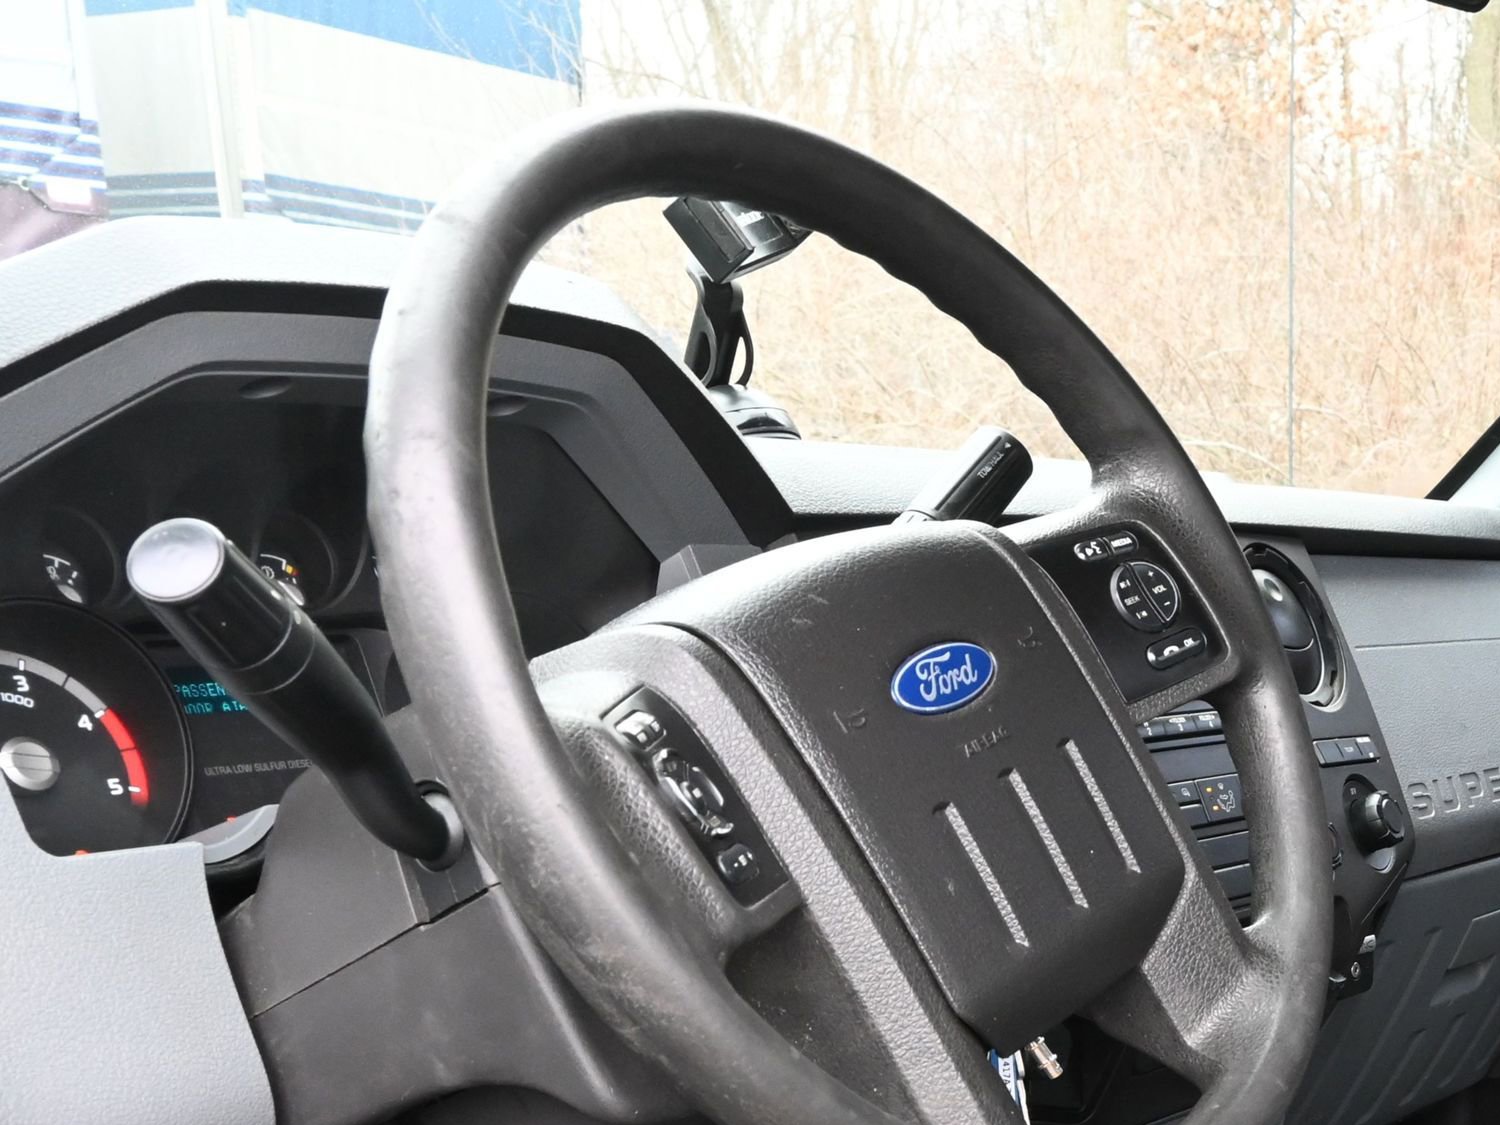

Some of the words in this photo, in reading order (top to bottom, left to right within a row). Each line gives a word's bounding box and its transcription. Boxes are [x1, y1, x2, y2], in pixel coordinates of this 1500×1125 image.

[1152, 584, 1167, 595] VOL
[1124, 595, 1141, 607] SEEK
[1183, 637, 1195, 648] OK
[12, 675, 30, 692] 3
[915, 651, 978, 702] Ford
[173, 682, 227, 698] PASSEN
[77, 714, 94, 731] 4
[203, 764, 232, 777] ULTRA
[234, 763, 253, 774] LOW
[254, 761, 288, 773] SULFUR
[107, 778, 124, 795] 5
